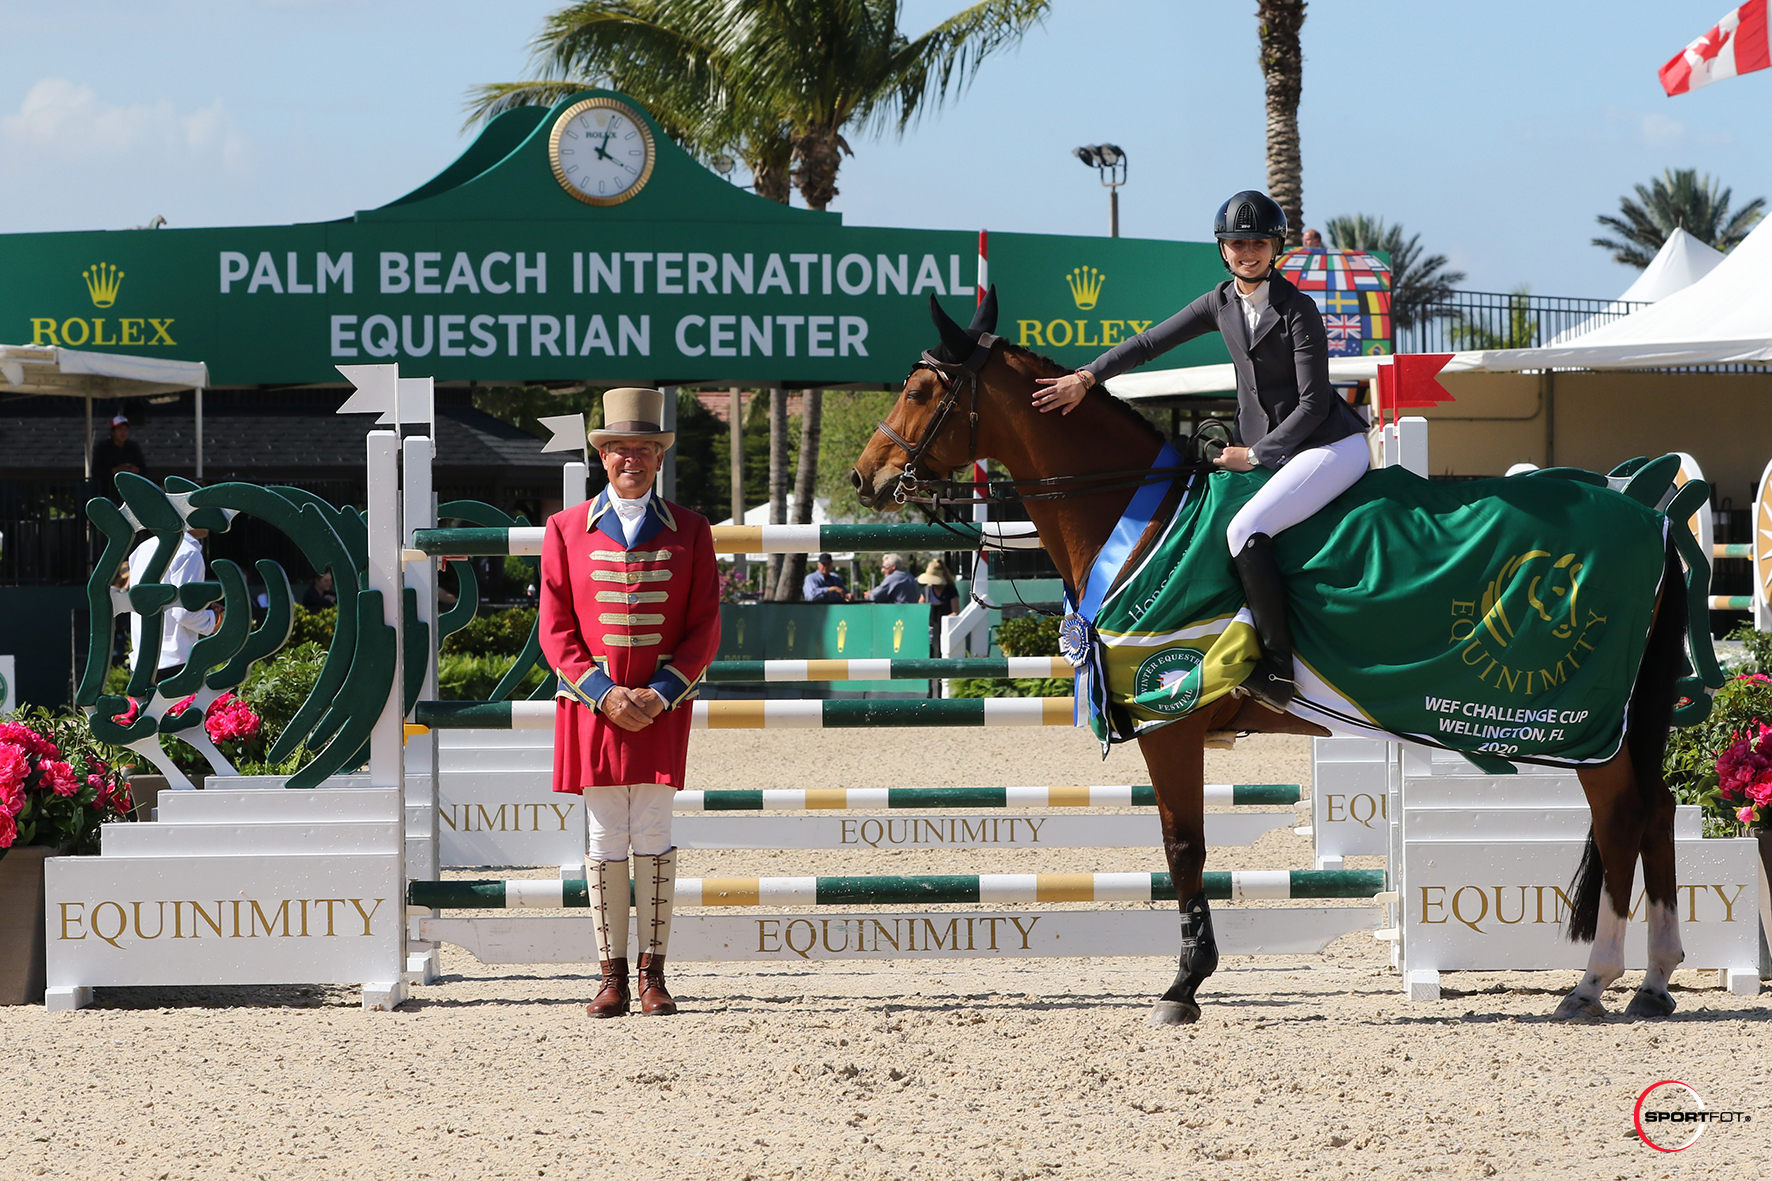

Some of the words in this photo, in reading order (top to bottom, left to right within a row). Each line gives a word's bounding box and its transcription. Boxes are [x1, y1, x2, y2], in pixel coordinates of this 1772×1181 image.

[220, 251, 353, 294] PALM
[379, 251, 547, 295] BEACH
[573, 251, 975, 296] INTERNATIONAL
[30, 317, 177, 346] ROLEX
[330, 314, 650, 357] EQUESTRIAN
[675, 314, 869, 357] CENTER
[1448, 599, 1607, 695] EQUINIMITY
[1158, 689, 1194, 711] FESTIVAL
[1425, 696, 1461, 714] WEF
[1462, 702, 1557, 724] CHALLENGE
[1559, 710, 1589, 724] CUP
[1439, 717, 1546, 743] WELLINGTON,
[1548, 728, 1565, 741] FL
[1478, 742, 1518, 755] 2020
[840, 817, 1047, 849] EQUINIMITY
[57, 898, 387, 950] EQUINIMITY
[1418, 884, 1750, 935] EQUINTY
[755, 915, 1042, 960] EQUINIMITY
